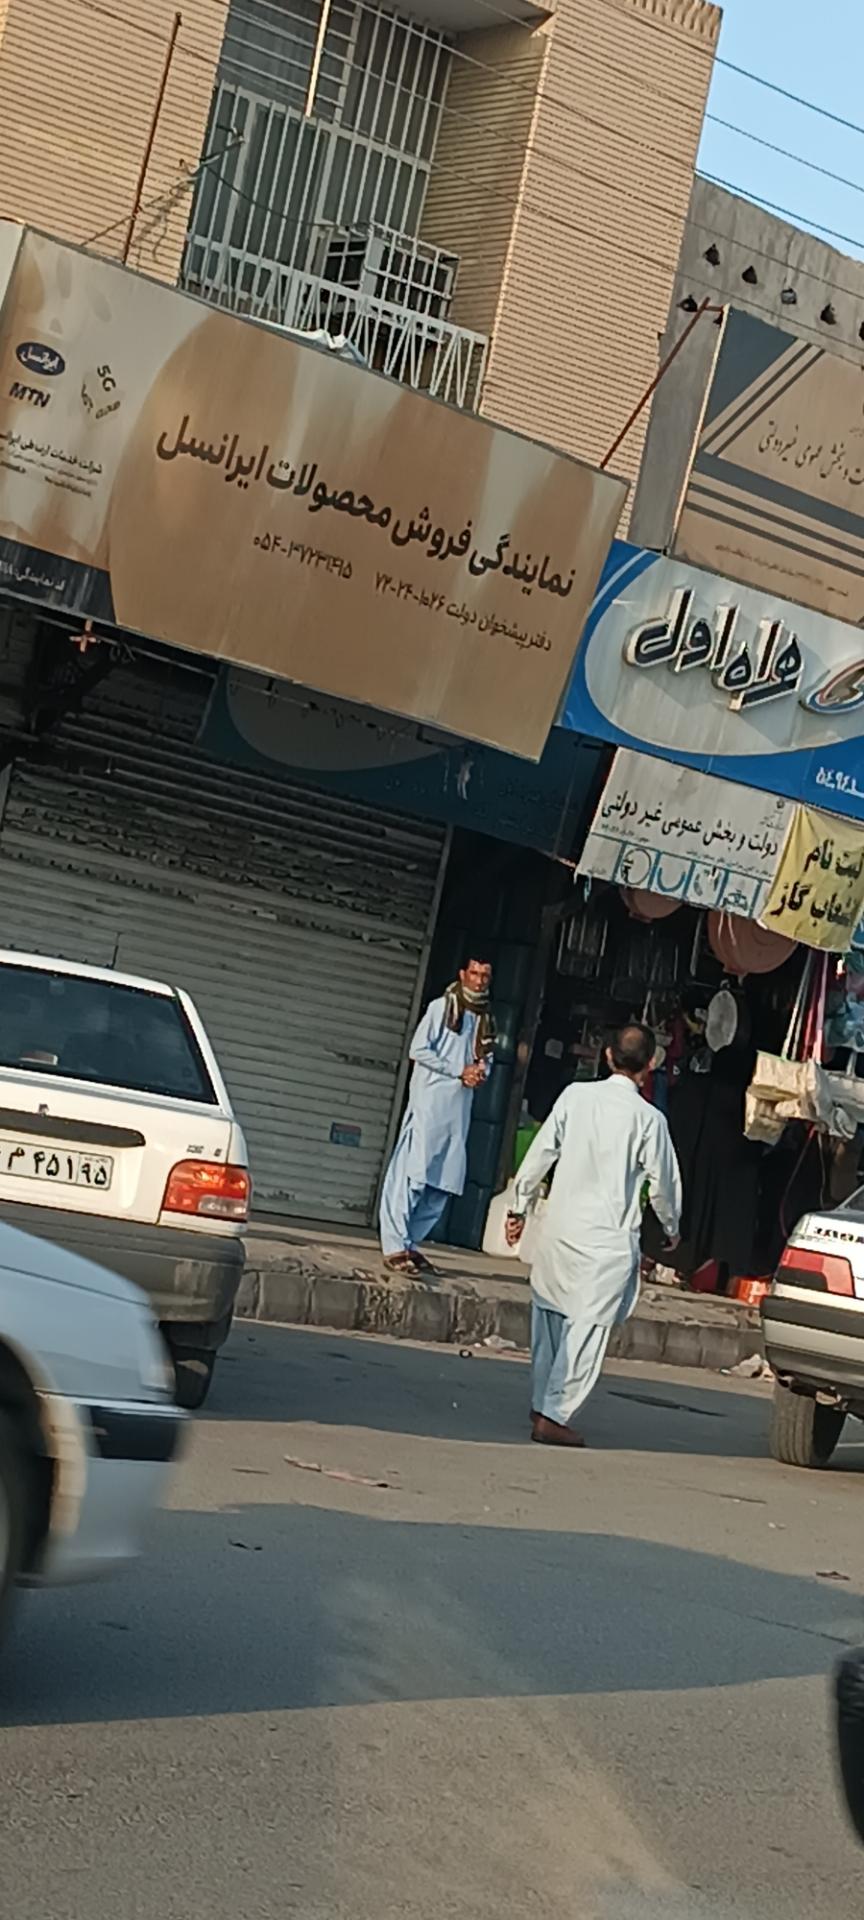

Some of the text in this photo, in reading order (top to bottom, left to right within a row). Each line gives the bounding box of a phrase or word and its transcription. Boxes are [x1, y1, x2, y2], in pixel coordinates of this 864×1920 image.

[9, 381, 51, 408] MTN
[96, 364, 116, 392] 5G
[156, 414, 269, 489] ایرانسل
[265, 459, 392, 528] محصولات
[391, 506, 472, 560] فروش
[468, 533, 577, 597] نمایندگی
[446, 603, 477, 626] دولت
[623, 585, 804, 713] همراه اول
[601, 789, 638, 820] دولتی
[637, 801, 662, 827] غیر
[661, 817, 702, 838] عمومی
[702, 819, 736, 853] بخش
[735, 833, 746, 852] و
[748, 831, 778, 860] دولت
[804, 838, 834, 873] نام
[769, 881, 813, 917] گاز
[7, 1146, 107, 1186] م ۴۵۱ ۹۵
